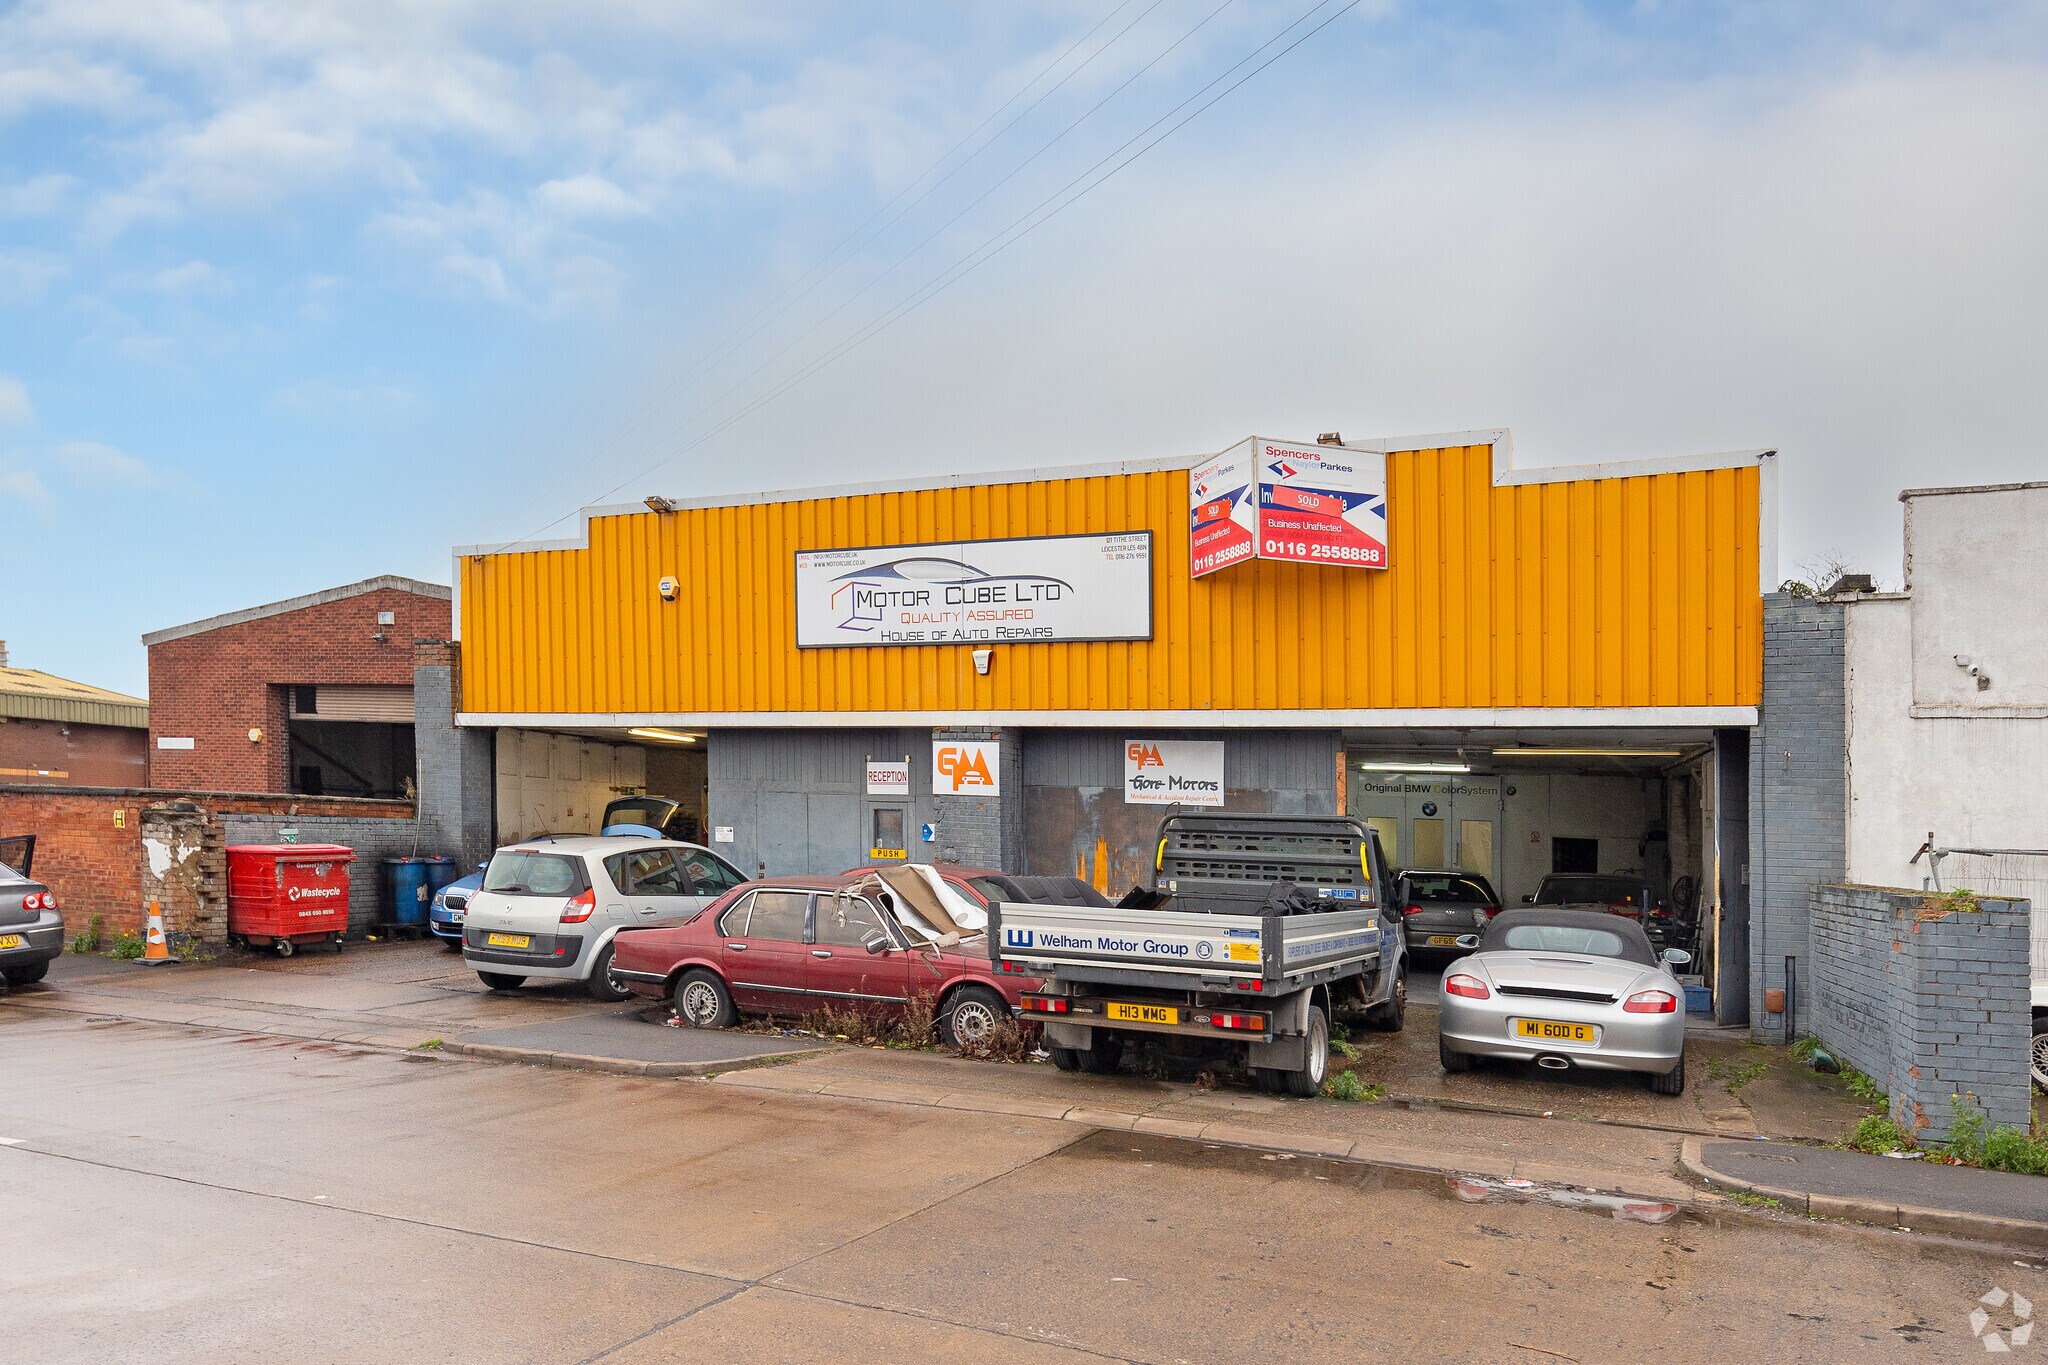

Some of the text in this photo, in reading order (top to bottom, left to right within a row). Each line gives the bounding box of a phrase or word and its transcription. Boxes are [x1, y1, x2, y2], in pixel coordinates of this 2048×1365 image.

[1265, 445, 1321, 461] Spencers
[1297, 494, 1320, 507] SOLD
[1207, 505, 1220, 515] SOLD
[1268, 518, 1301, 529] Business
[1302, 521, 1342, 533] Unaffected
[1194, 536, 1210, 547] Business
[1101, 545, 1127, 553] LEICESTER
[1194, 541, 1251, 571] 0116 2558888
[1265, 540, 1380, 562] 0116 2558888
[857, 589, 930, 608] MOTOR
[946, 586, 1007, 605] CUBE
[901, 608, 1034, 625] QUALITY ASSURED
[881, 626, 1053, 642] HOUSE OF AUTO REPAIRS
[868, 771, 907, 782] RECEPTION
[1364, 783, 1498, 796] Original BMW ColorSystem
[115, 812, 124, 827] H
[877, 850, 899, 858] PUSH
[301, 886, 341, 898] Wastecycle
[1039, 933, 1093, 949] Welham
[1097, 937, 1139, 952] Motor
[1143, 939, 1189, 958] Group
[1433, 937, 1454, 945] GF65
[1119, 1005, 1167, 1021] H13 WMG
[1575, 1027, 1584, 1039] G
